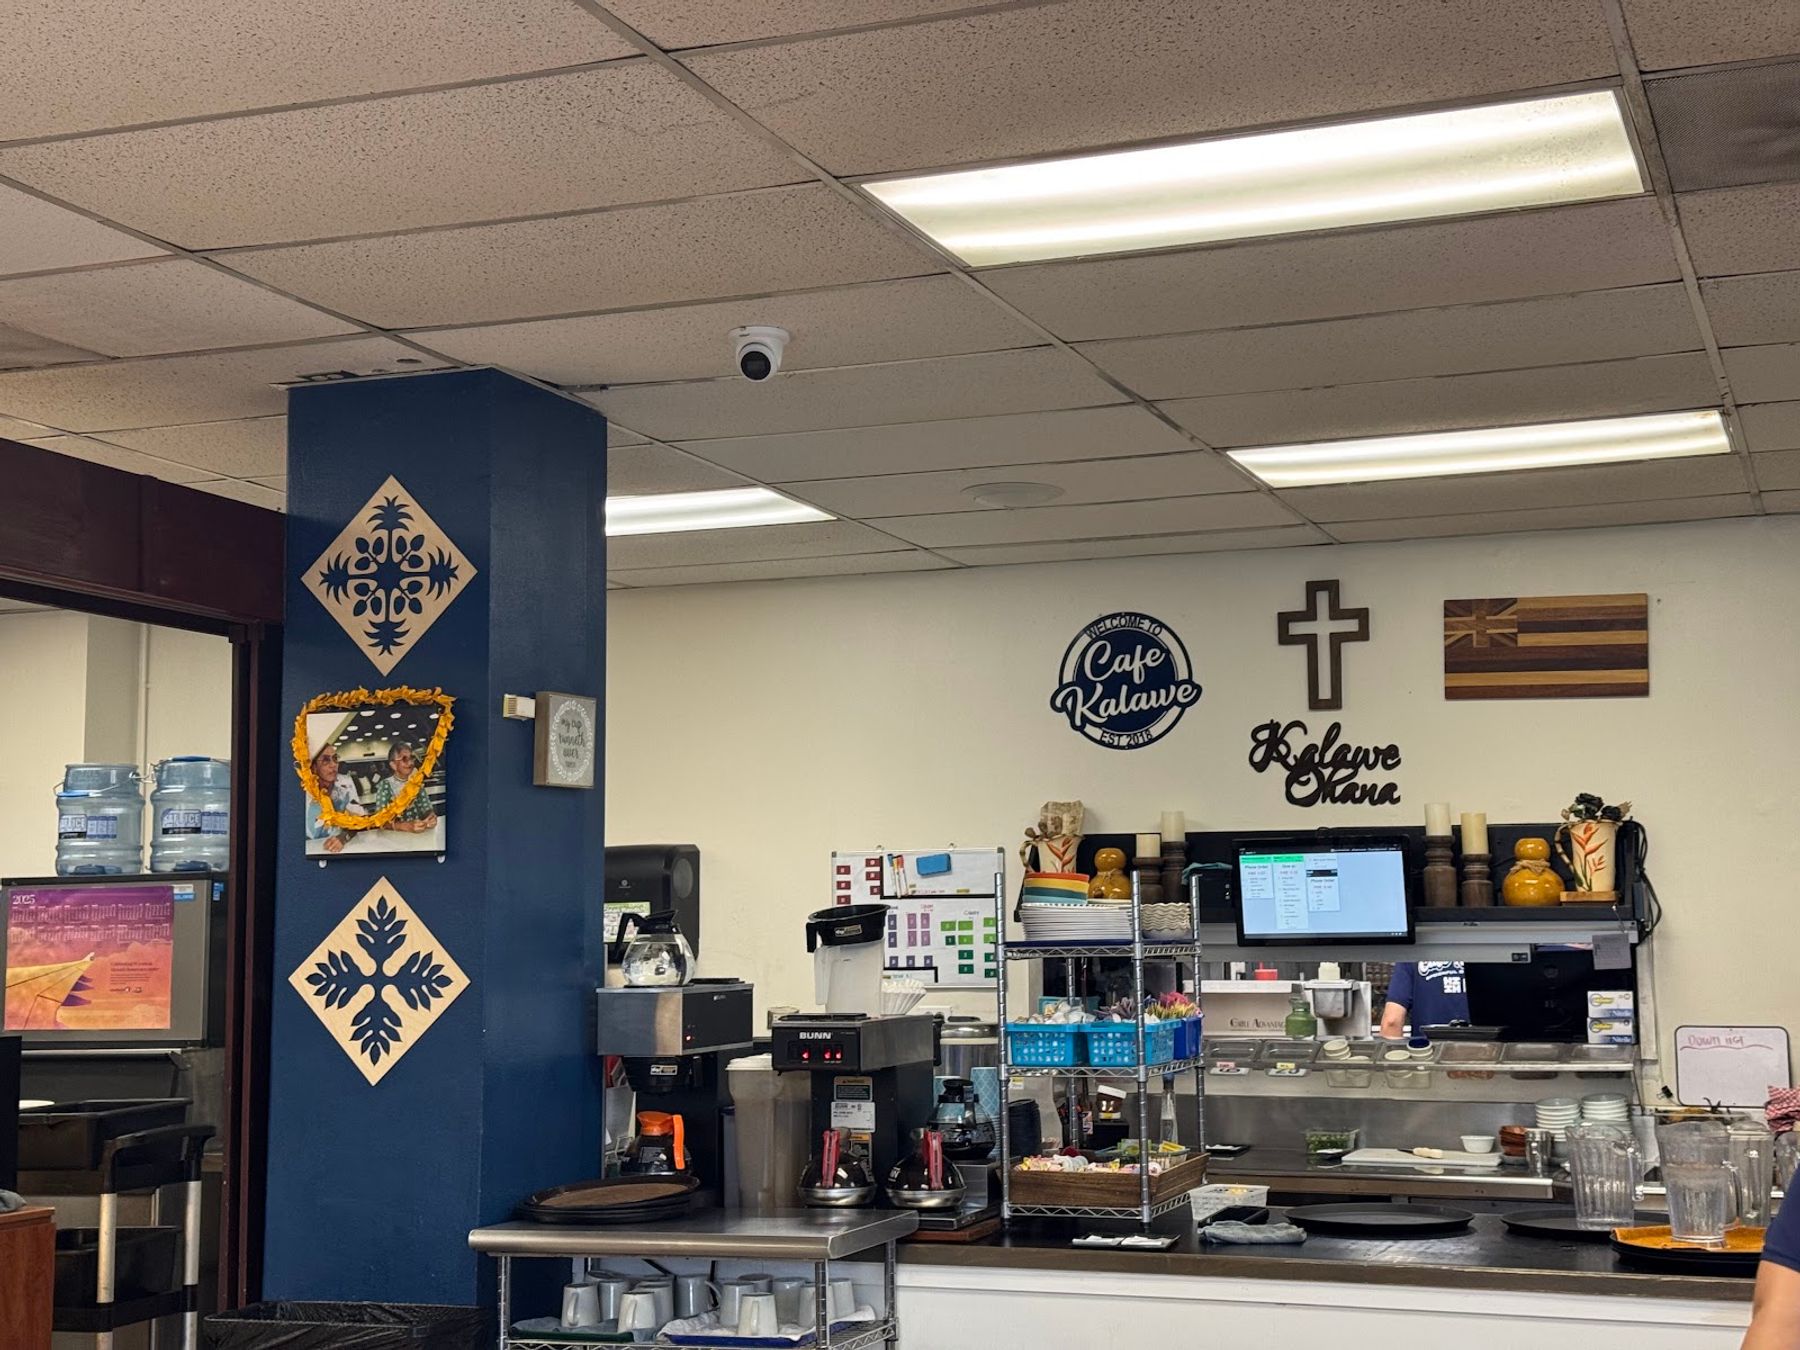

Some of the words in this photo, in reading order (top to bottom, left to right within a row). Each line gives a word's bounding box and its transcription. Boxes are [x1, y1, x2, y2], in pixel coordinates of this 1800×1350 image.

[1085, 615, 1145, 639] WELCOME
[1146, 620, 1163, 637] TO
[1084, 640, 1165, 684] Cafe
[1055, 682, 1198, 726] Kalawe
[1100, 732, 1123, 746] EST
[1124, 730, 1153, 746] 2018
[1249, 719, 1401, 773] Kalawe
[1285, 767, 1401, 807] Ohana
[799, 1032, 832, 1040] BUNN
